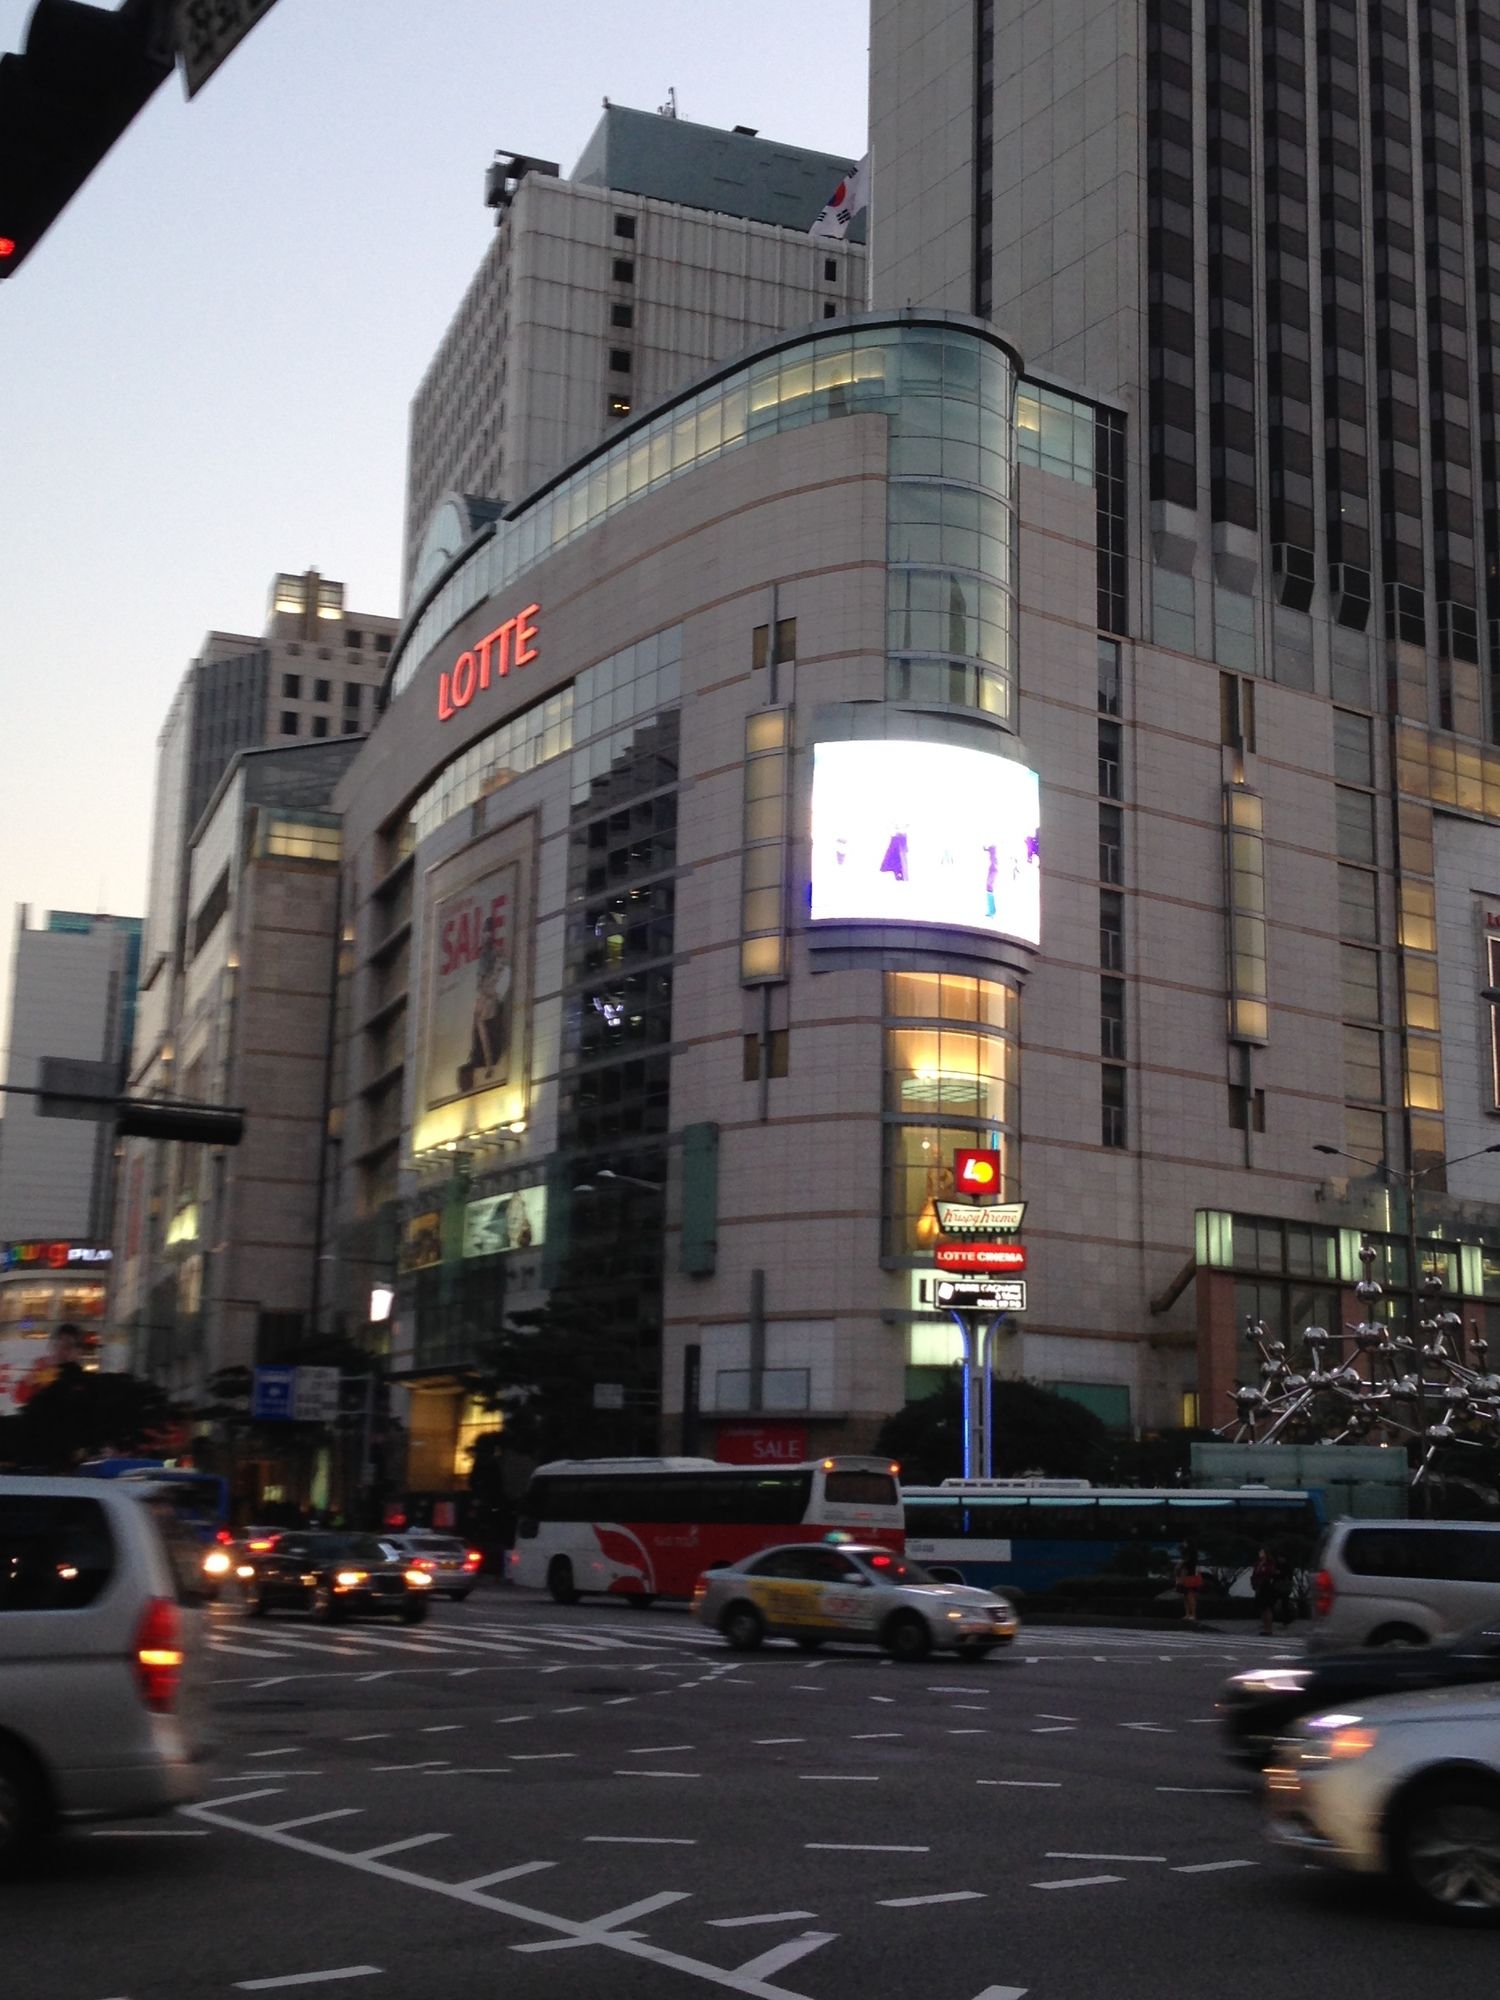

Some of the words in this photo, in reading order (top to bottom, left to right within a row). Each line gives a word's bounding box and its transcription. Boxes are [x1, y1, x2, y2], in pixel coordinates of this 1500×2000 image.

[438, 602, 541, 721] LOTTE
[440, 895, 508, 975] SALE
[937, 1251, 976, 1262] LOTTE
[976, 1252, 1024, 1263] CINEMA
[753, 1439, 801, 1459] SALE
